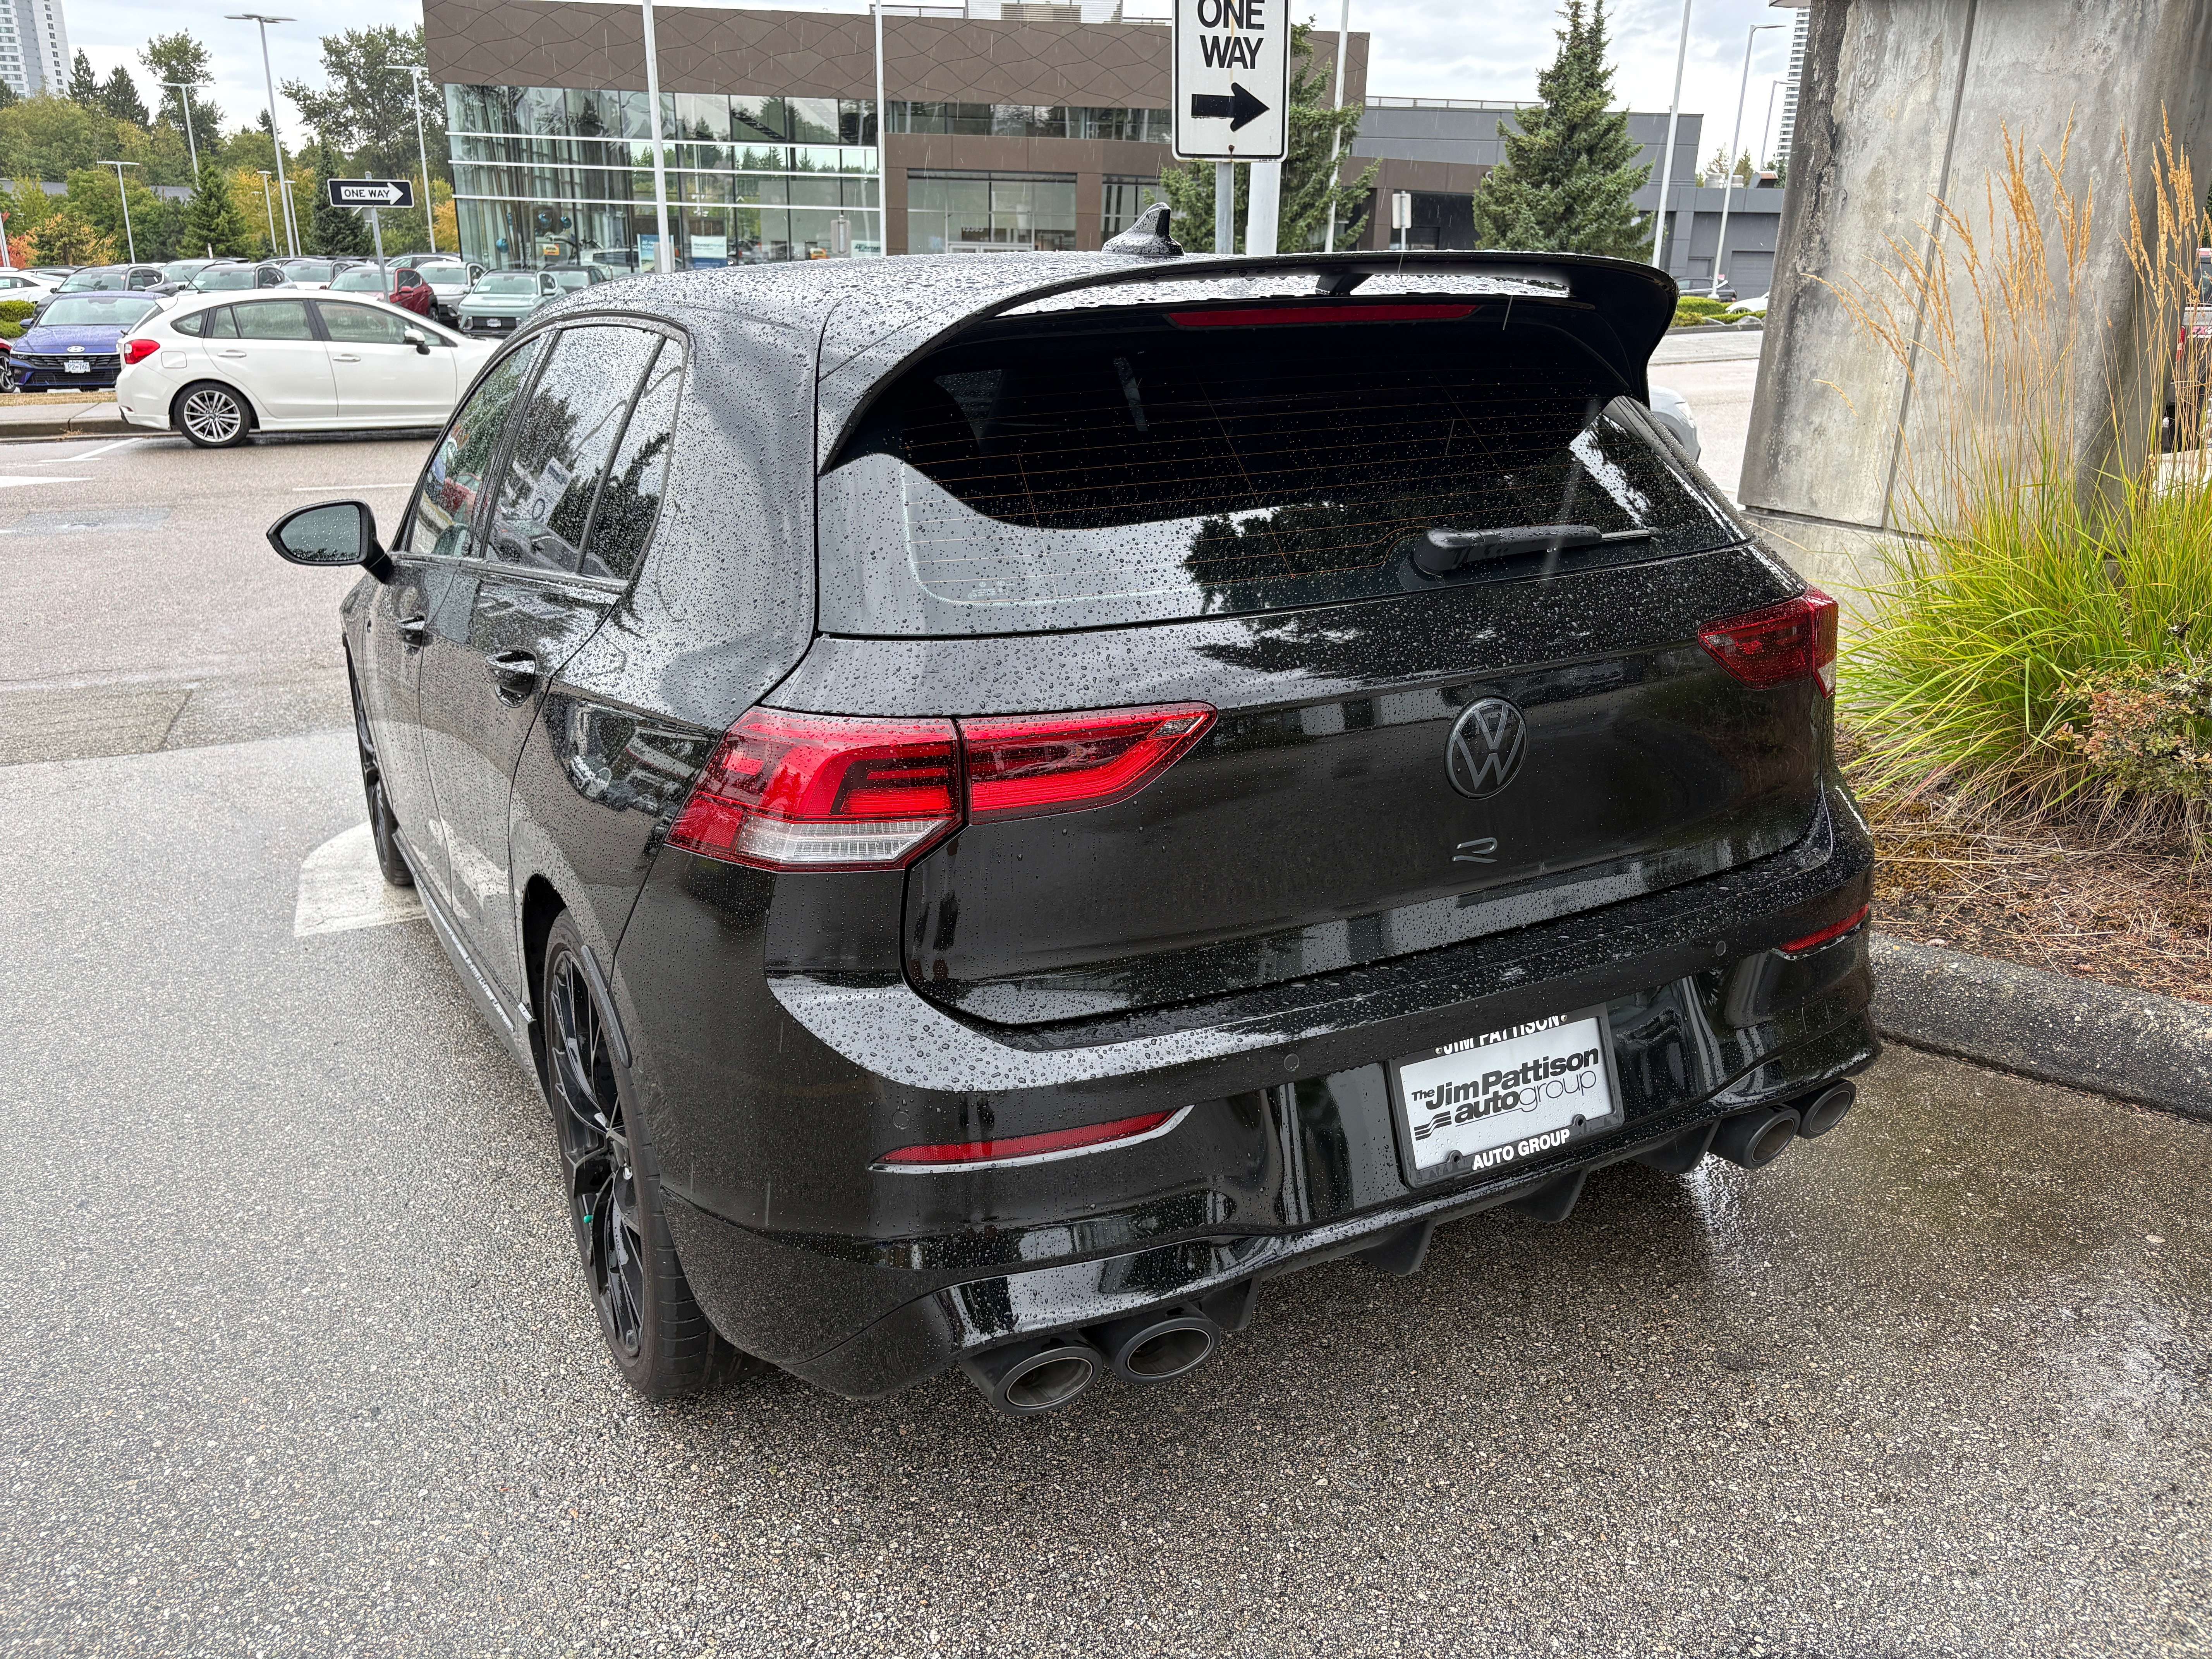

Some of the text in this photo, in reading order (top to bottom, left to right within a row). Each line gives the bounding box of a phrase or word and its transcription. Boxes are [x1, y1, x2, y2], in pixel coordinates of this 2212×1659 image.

[1197, 0, 1265, 30] ONE
[1199, 35, 1264, 69] WAY
[344, 189, 390, 198] ONE WAY
[1443, 1037, 1474, 1055] JIM
[1412, 1048, 1599, 1110] The Jim Pattison
[1472, 1128, 1570, 1171] AUTO GROUP
